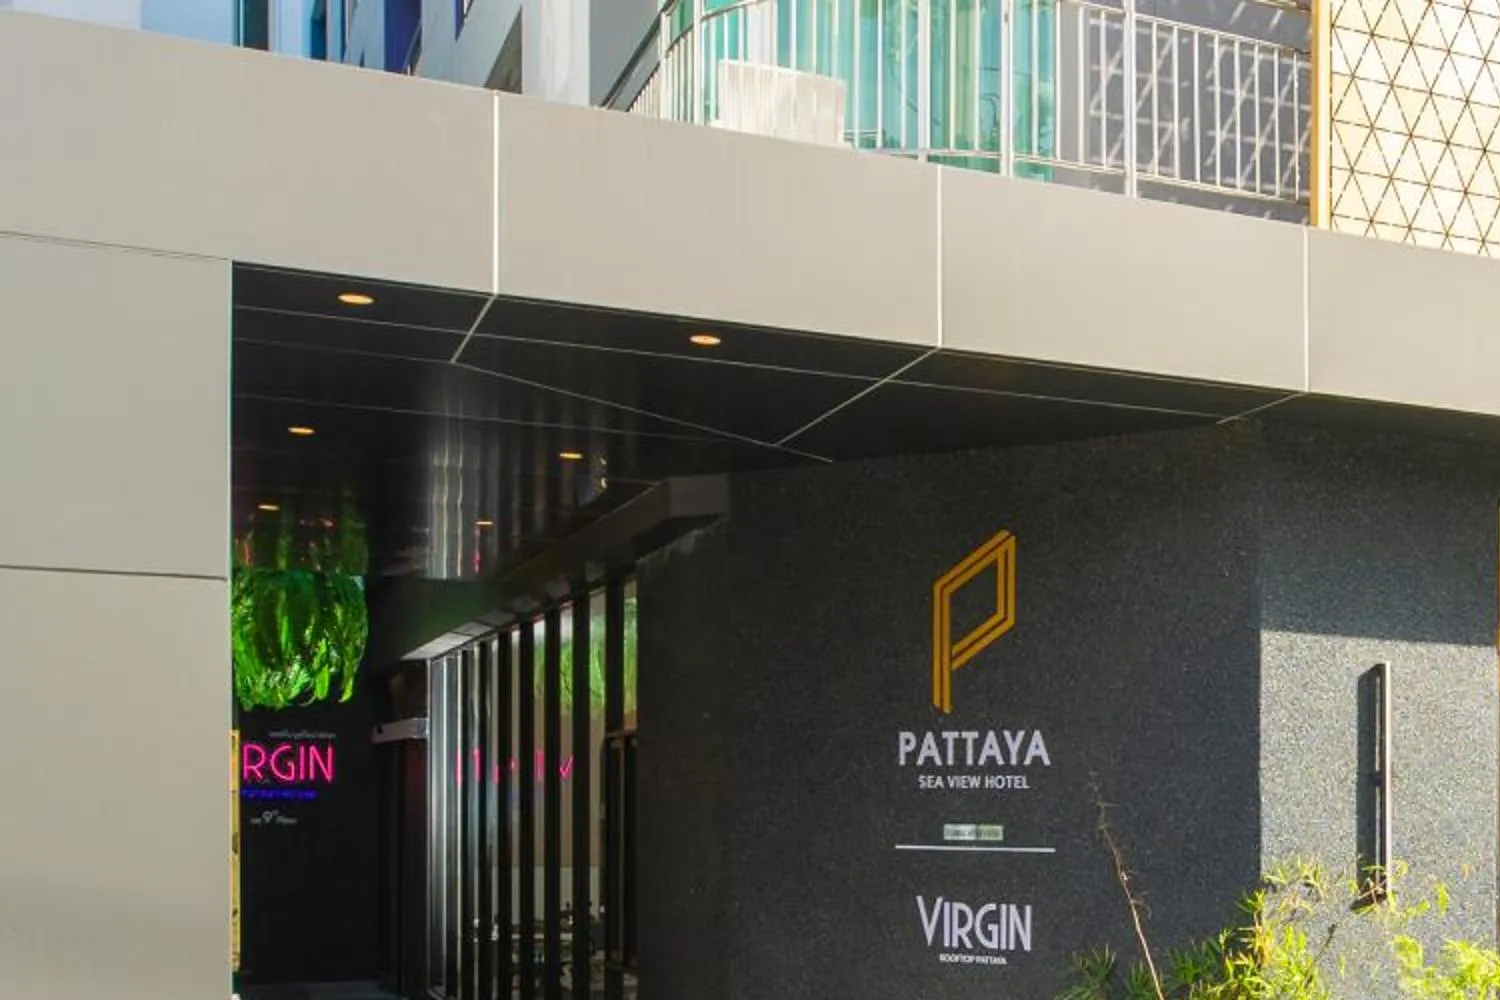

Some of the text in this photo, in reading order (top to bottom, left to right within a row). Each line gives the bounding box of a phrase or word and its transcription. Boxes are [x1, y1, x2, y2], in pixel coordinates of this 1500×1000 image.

[242, 743, 334, 783] RGIN
[899, 730, 1051, 766] PATTAYA
[918, 775, 1029, 789] SEA VIEW HOTEL
[916, 895, 1032, 951] VIRGIN
